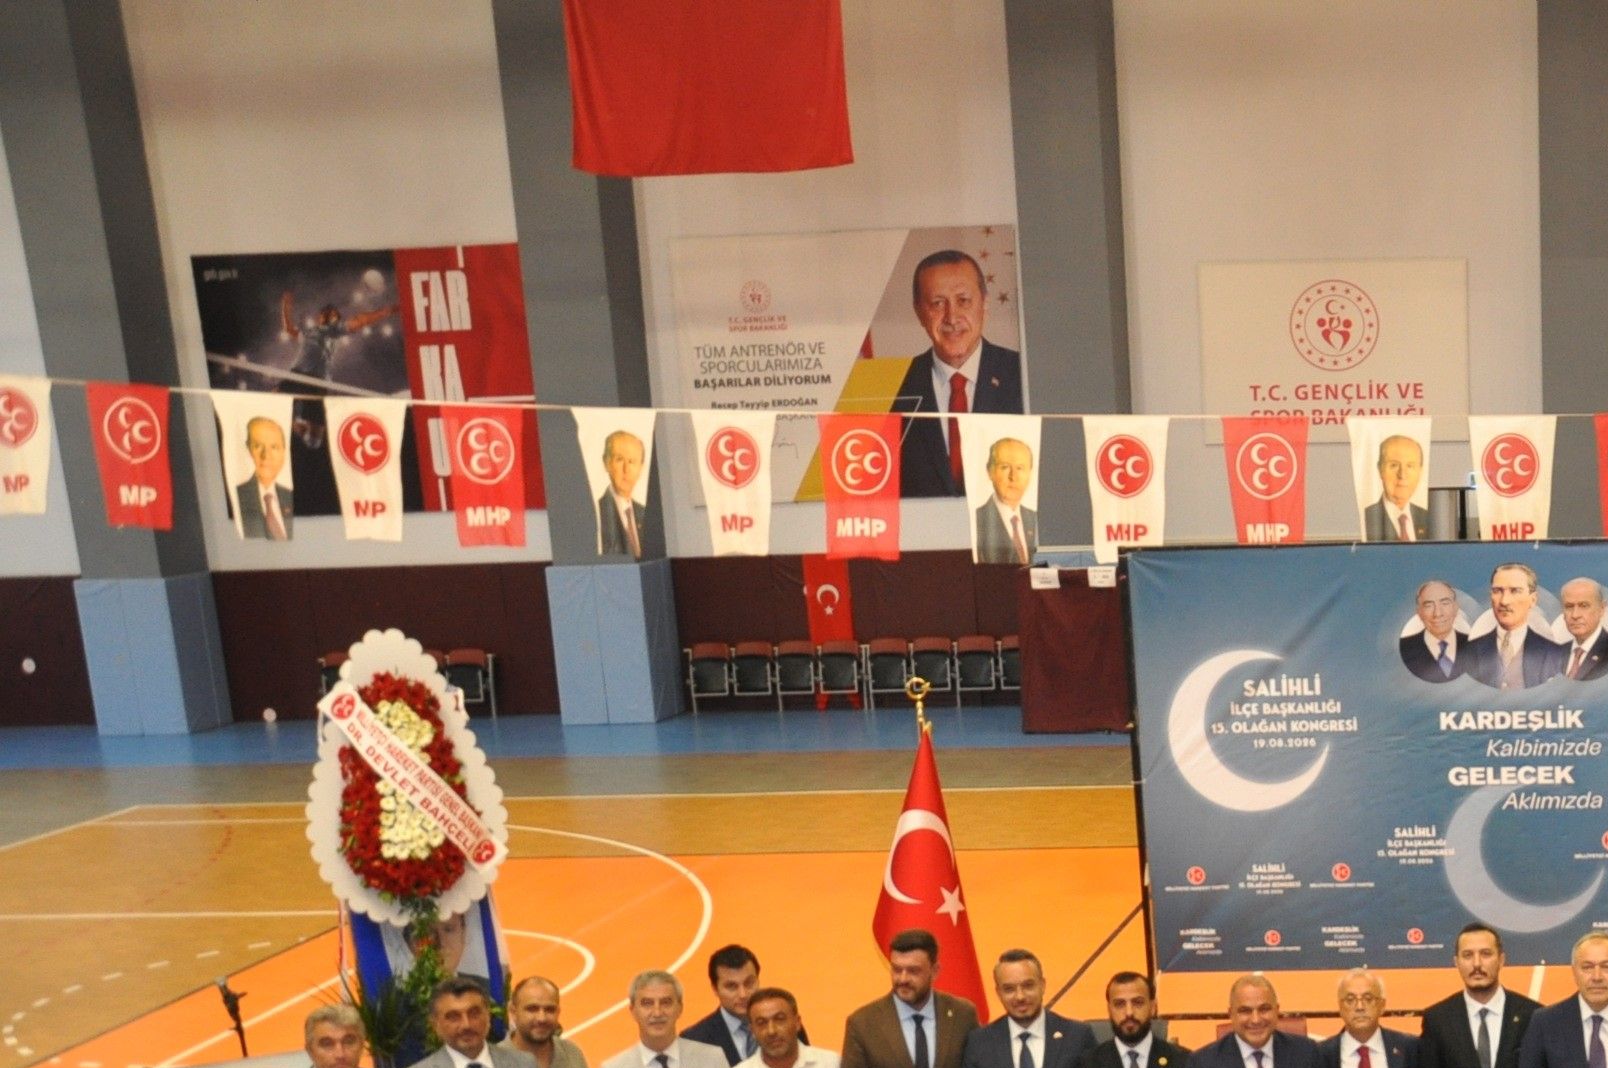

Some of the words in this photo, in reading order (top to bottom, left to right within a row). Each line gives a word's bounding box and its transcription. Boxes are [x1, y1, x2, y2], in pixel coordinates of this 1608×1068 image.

[410, 270, 472, 332] FAR
[694, 343, 726, 359] TÜM
[730, 341, 805, 357] ANTRENÖR
[809, 342, 826, 355] VE
[700, 358, 823, 374] SPORCULARIMIZA
[694, 376, 761, 391] BAŞARILAR
[764, 374, 832, 387] DİLİYORUM
[1250, 384, 1287, 401] T.C.
[1295, 380, 1389, 405] GENÇLİK
[1397, 382, 1424, 399] VE
[772, 397, 818, 407] ERDOĞAN
[466, 506, 511, 527] MHP
[836, 517, 887, 538] MHP
[1246, 523, 1290, 545] MHP
[1491, 522, 1535, 541] MHP
[1243, 673, 1321, 697] SALİHLİ
[1230, 701, 1258, 718] İLÇE
[1262, 699, 1341, 718] BAŞKANLIĞI
[1439, 705, 1584, 732] KARDEŞLİK
[1231, 718, 1287, 734] OLAĞAN
[1290, 717, 1358, 733] KONGRESİ
[1486, 738, 1603, 757] Kalbimizde
[365, 744, 419, 798] DEVLET
[1448, 765, 1575, 787] GELECEK
[1502, 791, 1604, 811] Aklımızda
[1394, 825, 1436, 838] SALİHLİ
